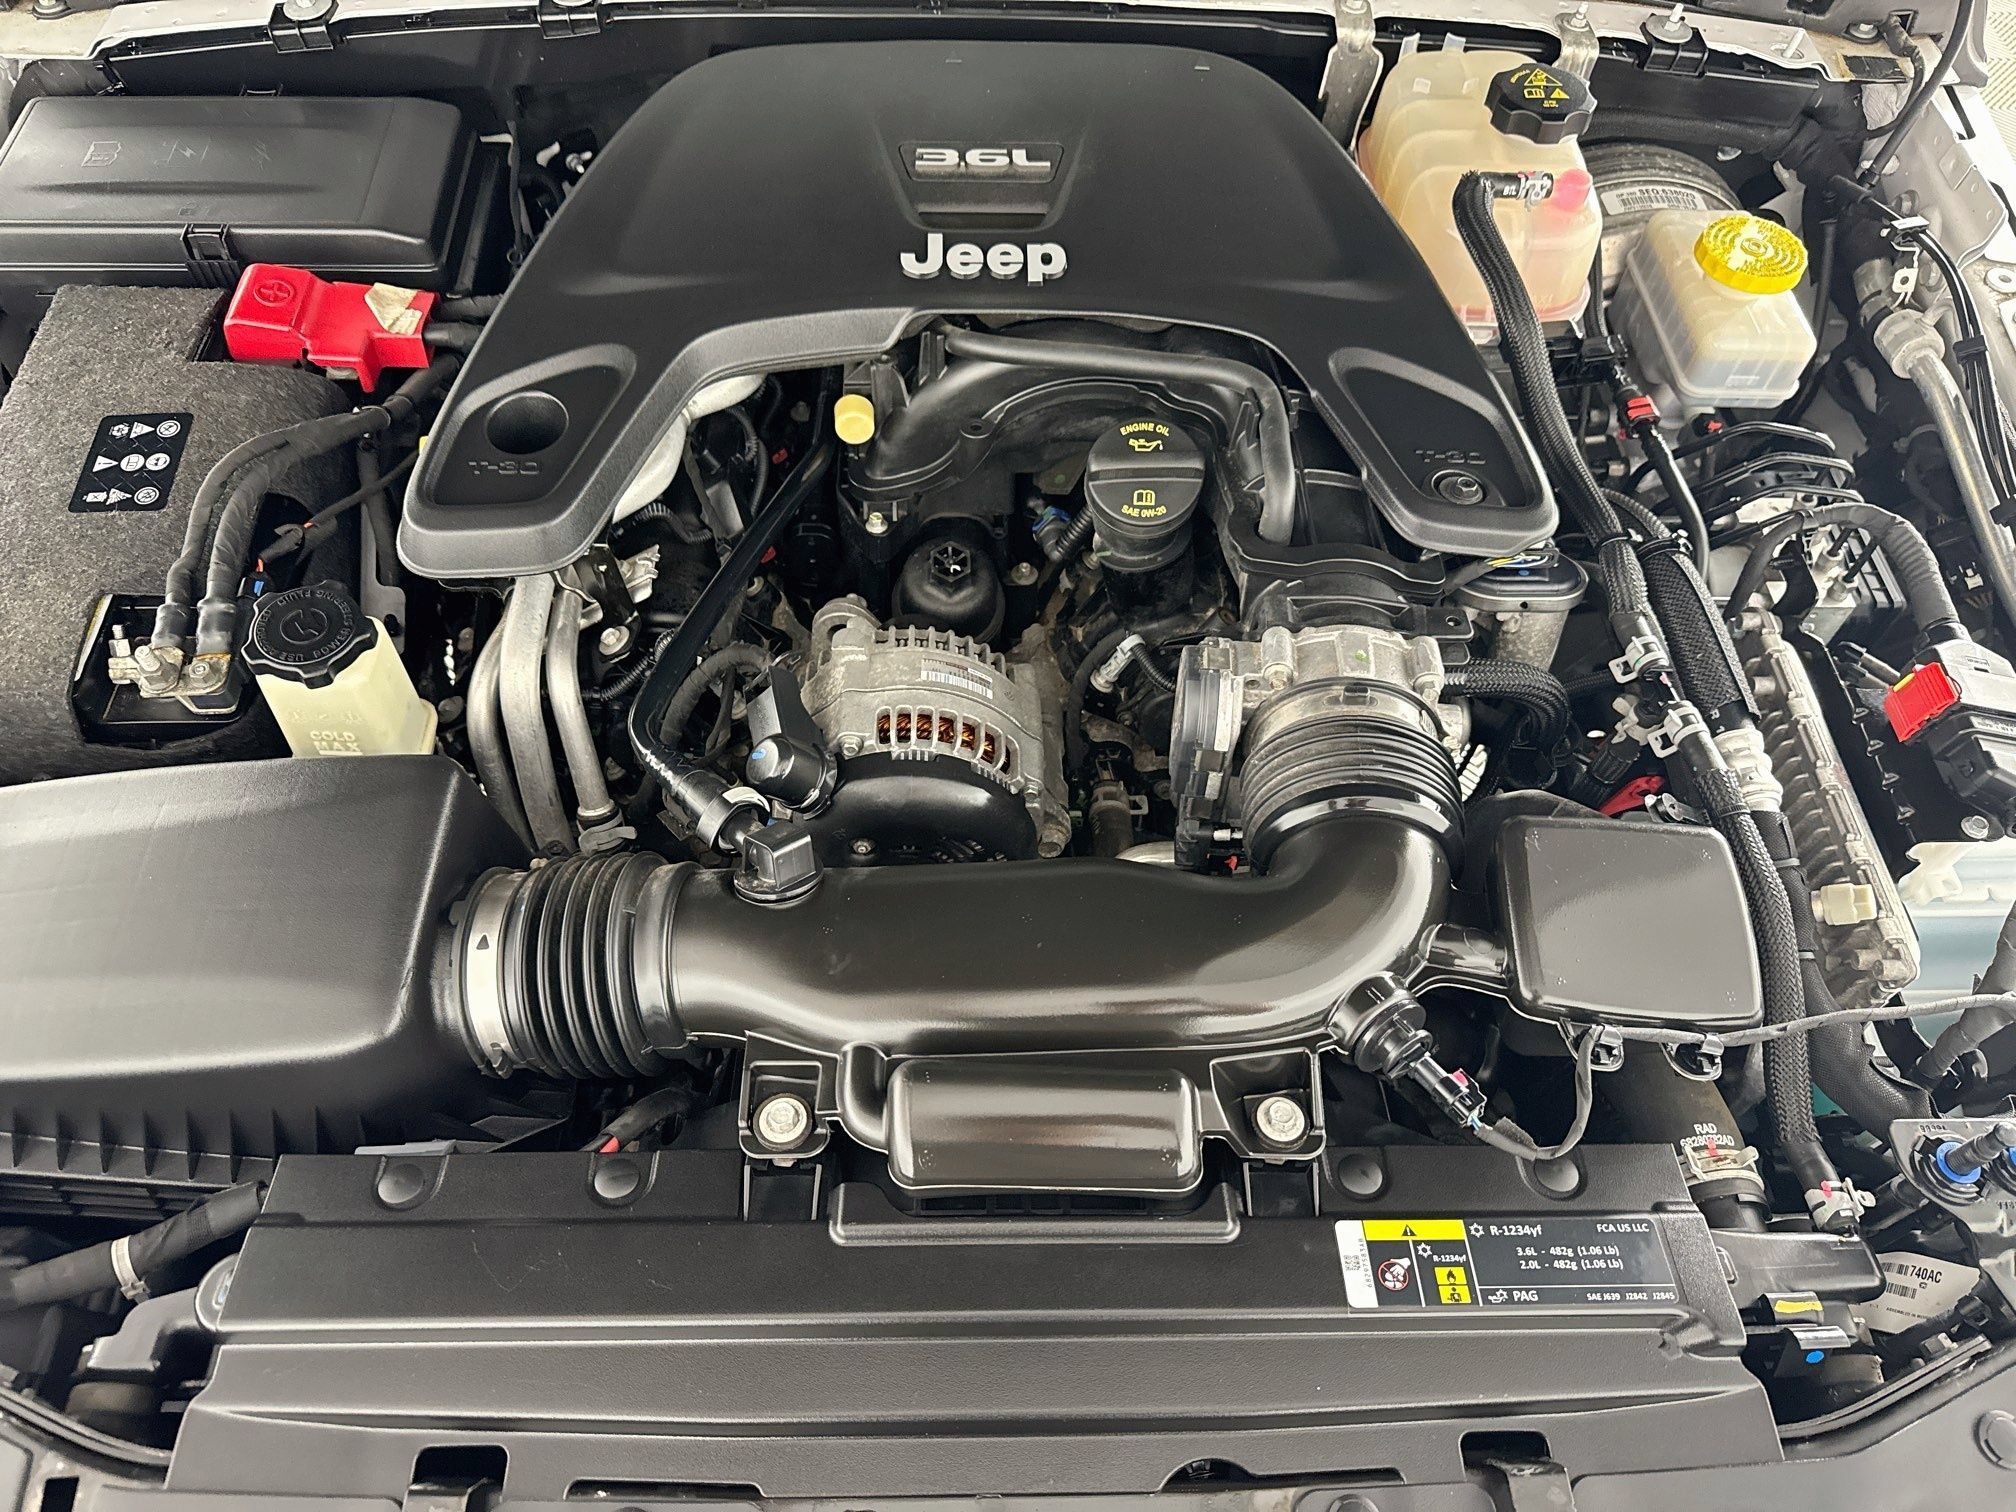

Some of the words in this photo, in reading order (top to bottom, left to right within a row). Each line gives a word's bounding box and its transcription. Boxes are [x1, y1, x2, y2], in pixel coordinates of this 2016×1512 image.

[915, 148, 1051, 169] 3.6L
[900, 232, 1067, 285] Jeep
[1120, 422, 1155, 436] ENGINE
[1155, 424, 1170, 437] OIL
[1121, 504, 1140, 517] SAE
[1140, 505, 1167, 518] 0W-20
[310, 730, 356, 742] COLD
[313, 741, 360, 752] MAX
[1693, 1122, 1718, 1135] RAD
[1489, 1224, 1542, 1238] R-1234yf
[1597, 1223, 1616, 1233] FCA
[1617, 1223, 1631, 1233] US
[1632, 1223, 1650, 1232] LLC
[1516, 1247, 1538, 1256] 3.6L
[1549, 1247, 1574, 1257] 482g
[1577, 1245, 1602, 1257] (1.06
[1603, 1245, 1620, 1256] Lb)
[1433, 1254, 1467, 1264] R-1234yf
[1519, 1260, 1541, 1270] 2.0L
[1553, 1260, 1578, 1271] 482g
[1581, 1259, 1606, 1270] (1.06
[1607, 1258, 1624, 1270] Lb)
[1909, 1264, 1943, 1284] 740AC
[1512, 1290, 1539, 1301] PAG
[1586, 1293, 1602, 1301] SAE
[1603, 1292, 1621, 1301] J639
[1625, 1292, 1648, 1301] J2842
[1652, 1291, 1675, 1300] J2845
